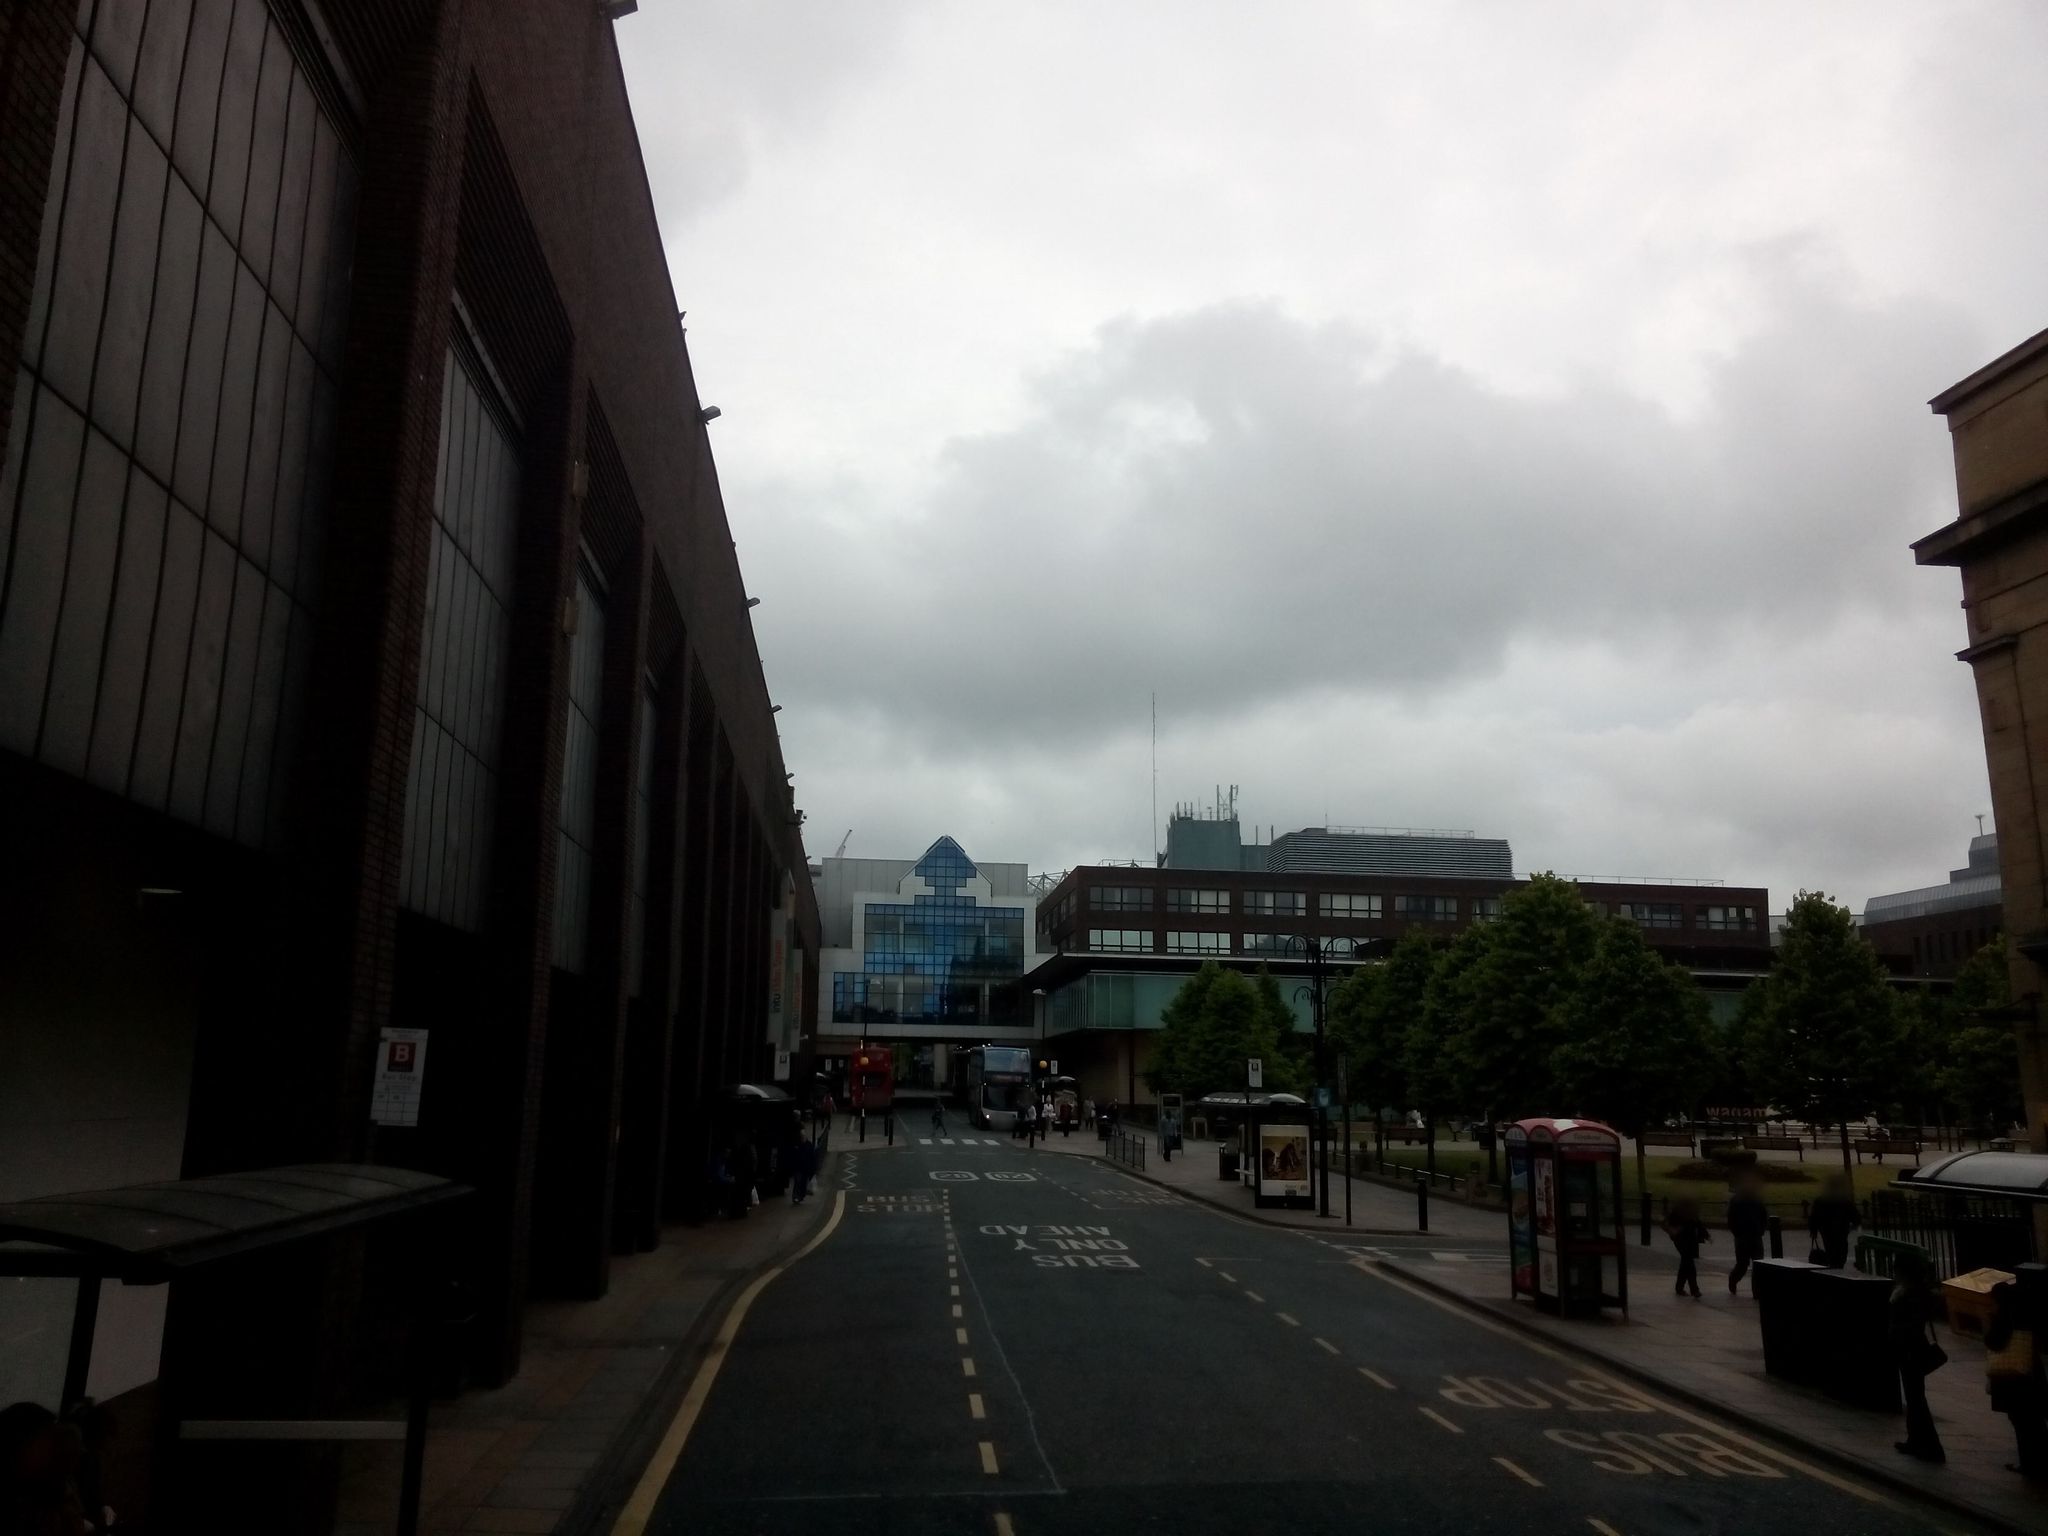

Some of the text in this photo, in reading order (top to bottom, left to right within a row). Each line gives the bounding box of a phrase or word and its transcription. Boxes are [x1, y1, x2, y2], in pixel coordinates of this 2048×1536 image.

[395, 1045, 410, 1062] B
[1706, 1106, 1767, 1118] wagam
[979, 1225, 1112, 1236] AHEAD
[1014, 1238, 1129, 1251] ONLY
[1031, 1254, 1141, 1269] BUS
[1439, 1374, 1657, 1413] STOP
[1542, 1428, 1790, 1479] BUS
